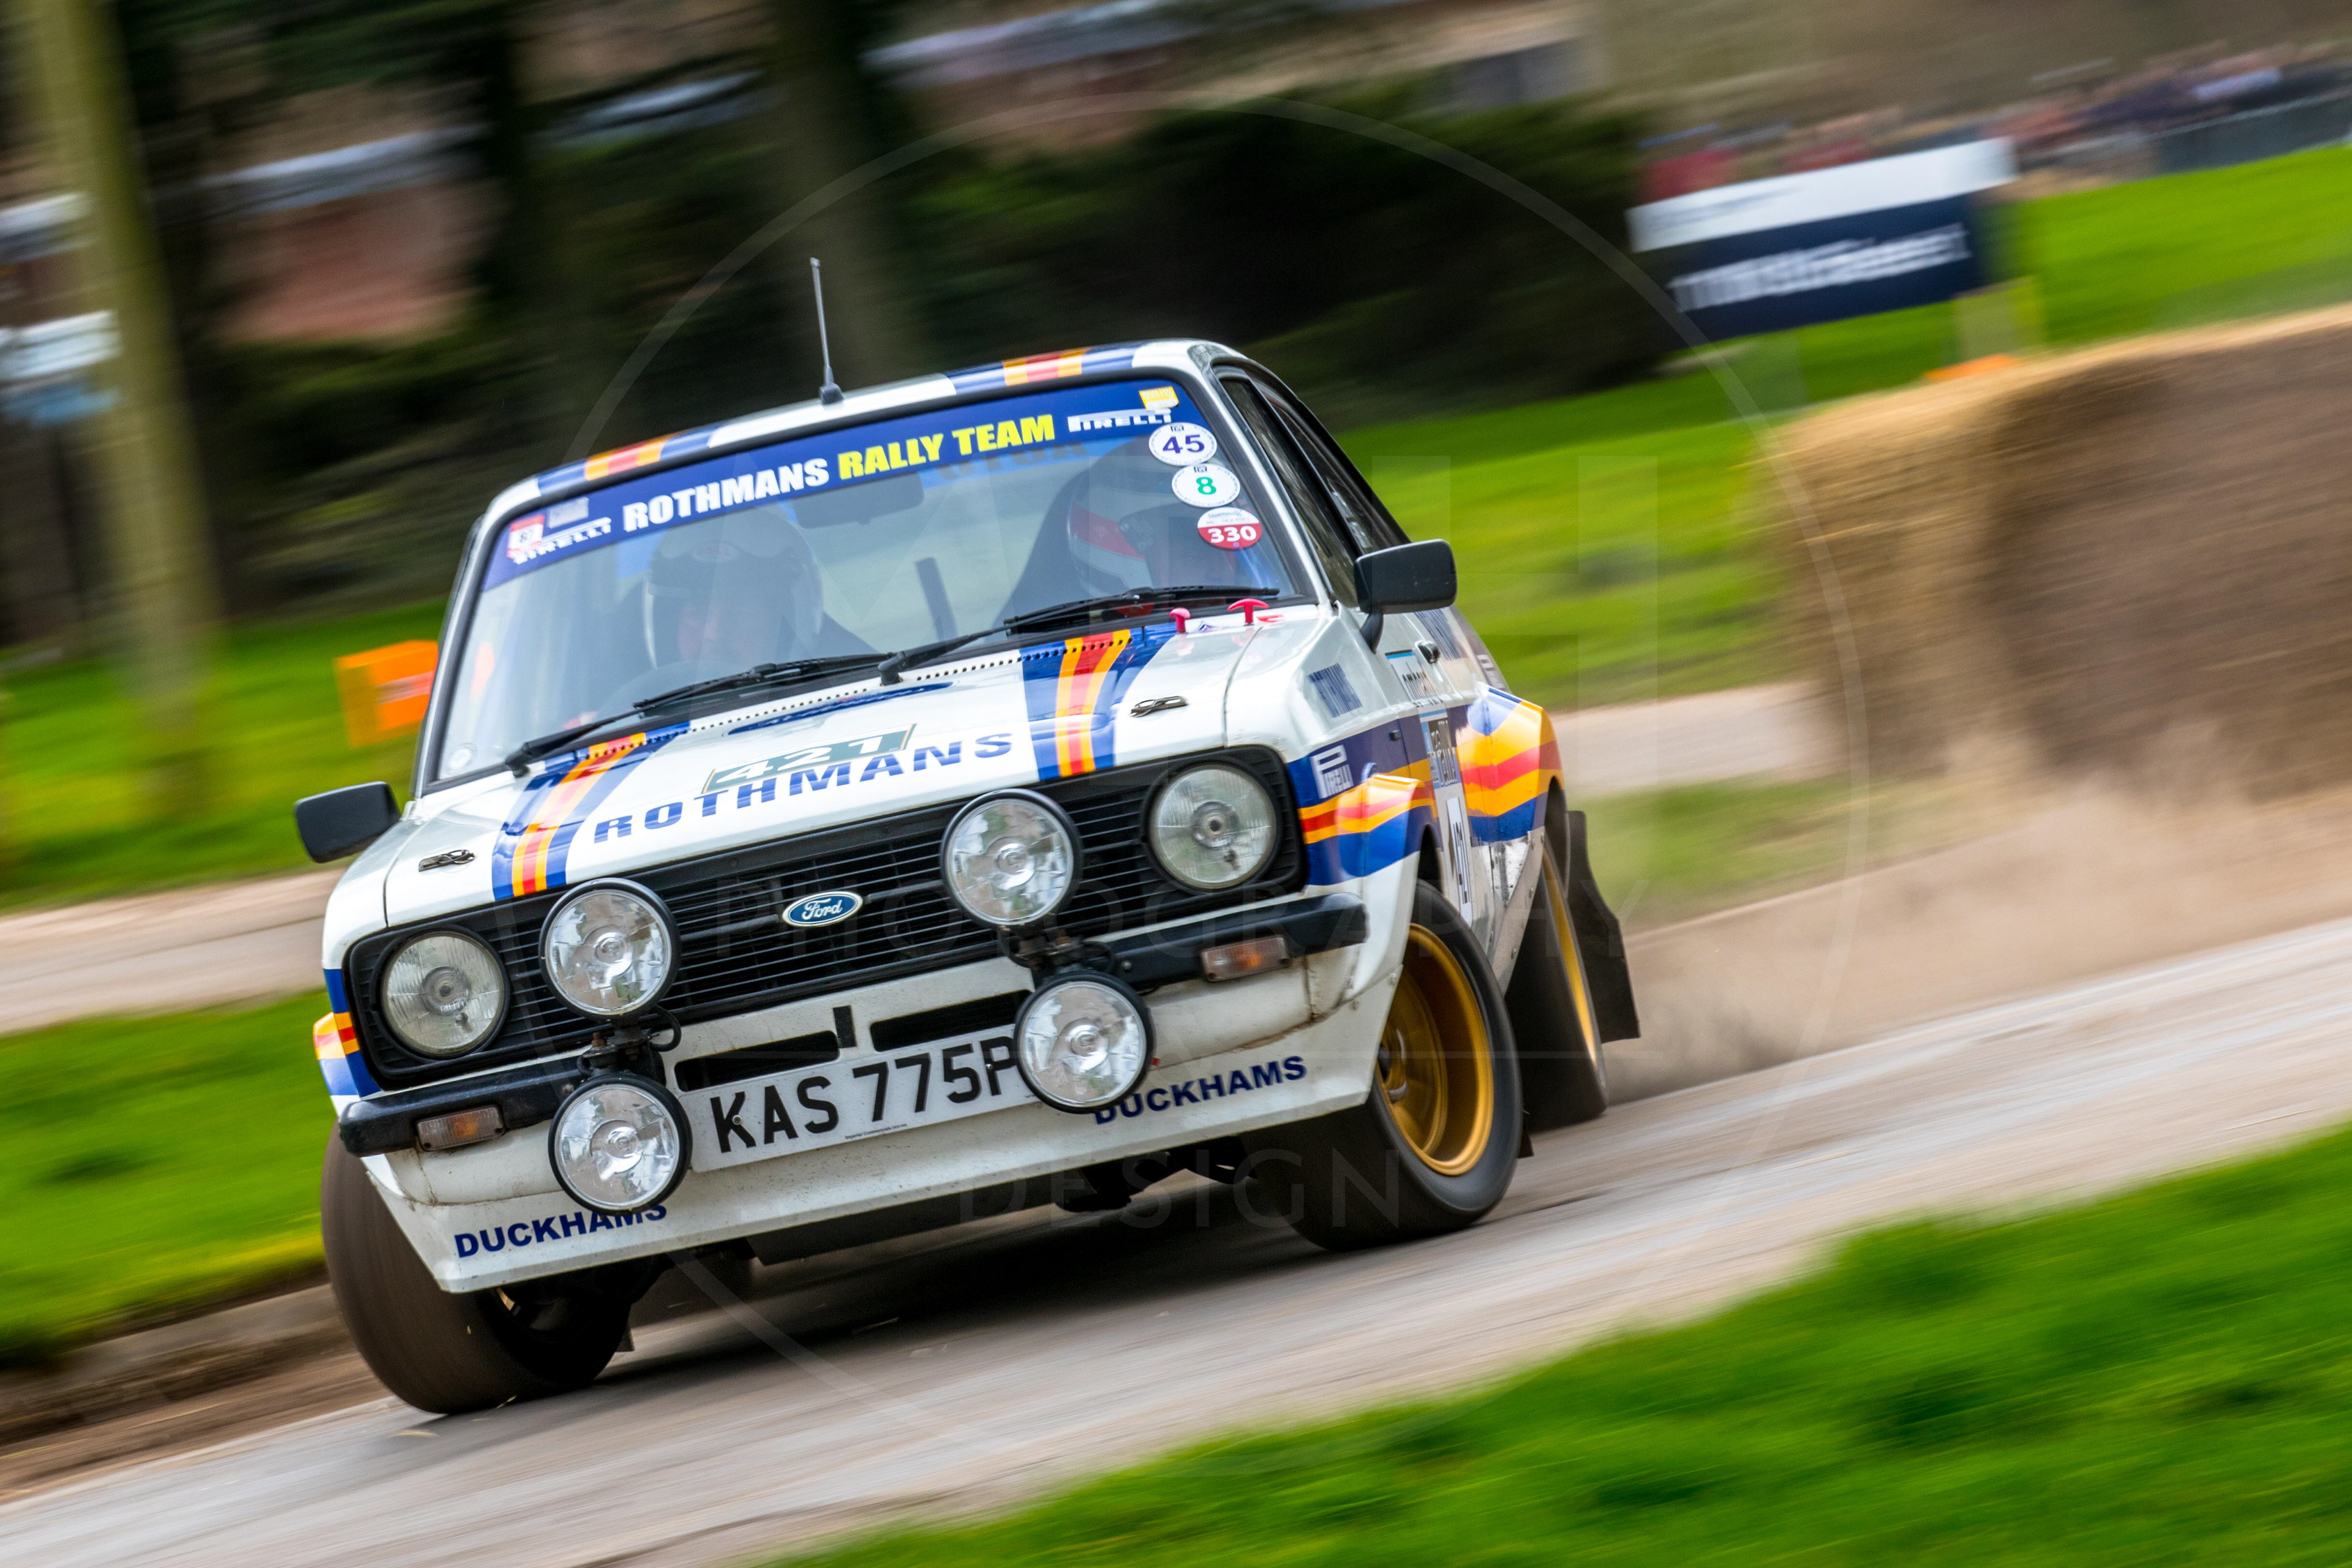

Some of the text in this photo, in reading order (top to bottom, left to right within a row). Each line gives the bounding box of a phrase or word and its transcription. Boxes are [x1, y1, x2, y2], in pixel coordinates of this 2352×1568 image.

[1067, 407, 1172, 432] PIRELLI
[1162, 434, 1205, 454] 45
[622, 458, 830, 532] ROTHMANS
[837, 432, 943, 480] RALLY
[952, 414, 1056, 456] TEAM
[1196, 476, 1217, 496] 8
[1207, 526, 1257, 543] 330
[715, 735, 884, 784] 421
[594, 732, 1014, 843] ROTHMANS
[801, 898, 843, 920] Ford
[710, 1036, 1018, 1153] KAS 775P
[1095, 1056, 1307, 1125] DUCKHAMS
